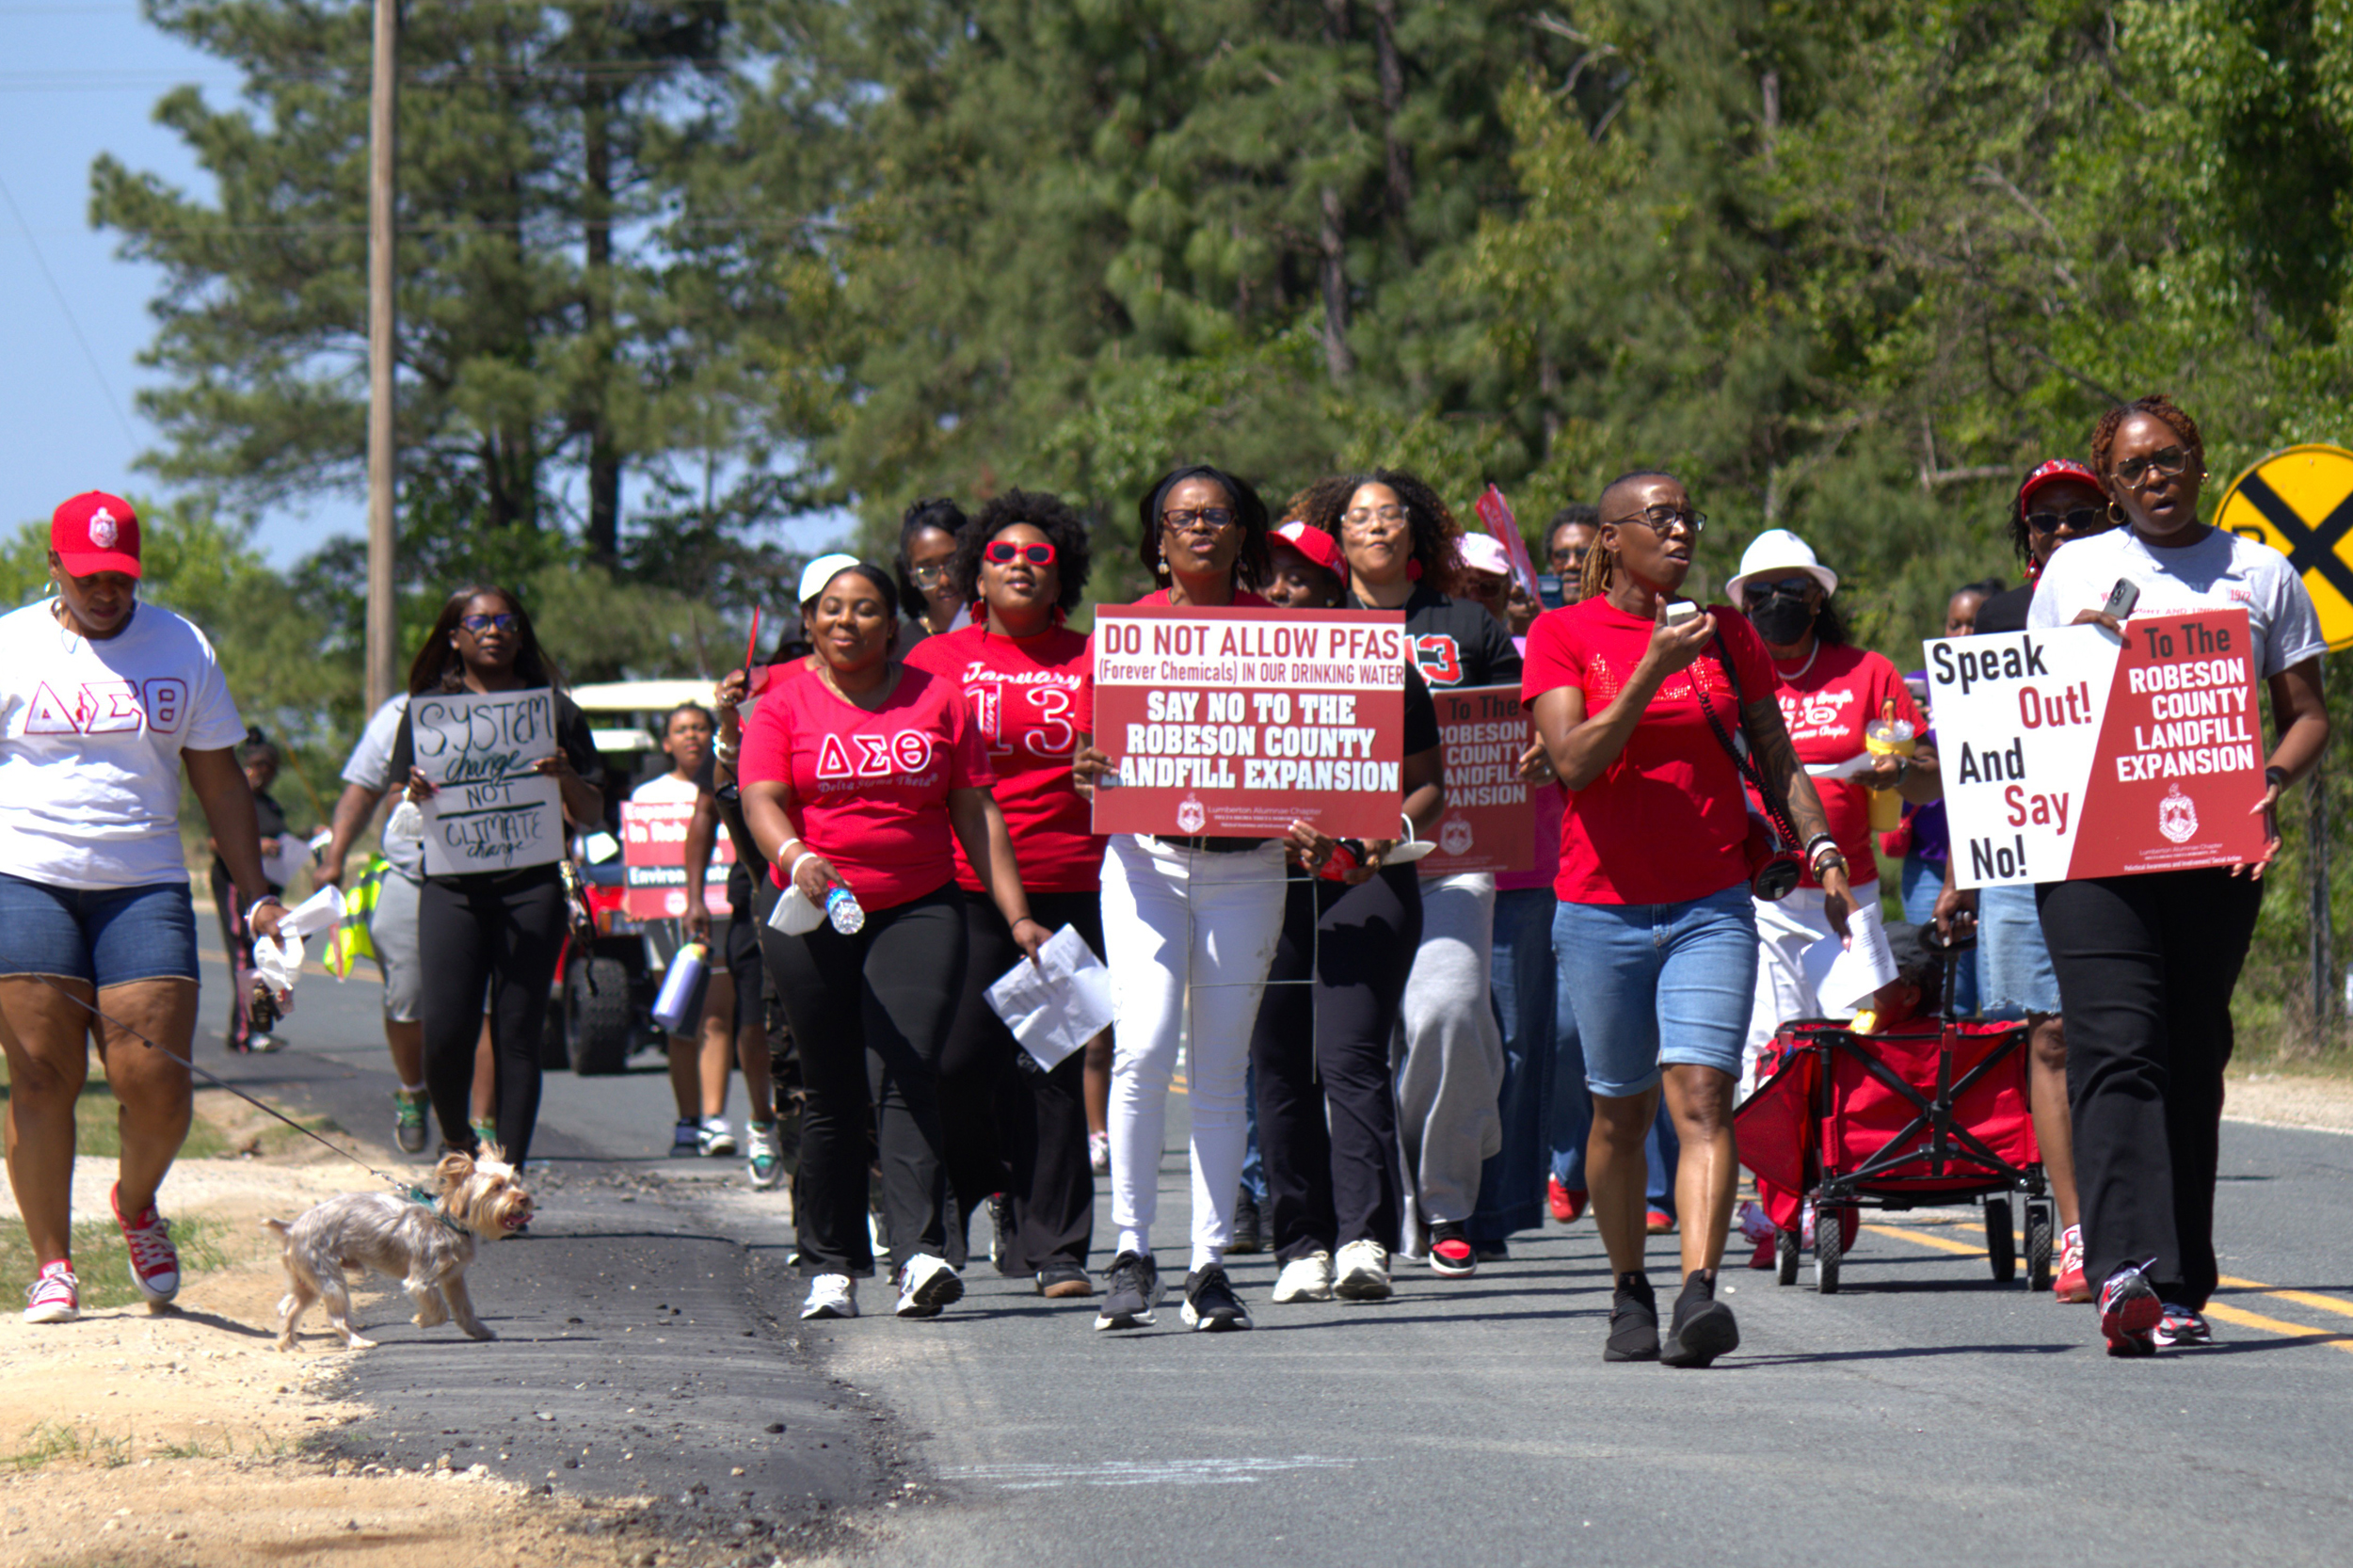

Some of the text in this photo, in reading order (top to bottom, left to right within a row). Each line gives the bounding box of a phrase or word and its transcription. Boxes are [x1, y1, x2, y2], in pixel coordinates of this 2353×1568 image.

[2230, 589, 2251, 602] 1972
[1105, 623, 1401, 660] DO NOT ALLOW PFAS
[2143, 622, 2232, 659] To The
[963, 662, 1081, 690] January
[1098, 658, 1404, 685] (Forever Chemicals) IN OUR DRINKING WATER
[1932, 634, 2049, 695] Speak
[2129, 657, 2246, 695] ROBESON
[1146, 690, 1357, 726] SAY NO TO THE
[1448, 694, 1519, 721] To The
[2018, 680, 2092, 729] Out!
[2152, 685, 2249, 721] COUNTY
[419, 696, 553, 757] SYSTEM
[1127, 723, 1376, 759] ROBESON COUNTY
[2135, 715, 2252, 752] LANDFILL
[445, 750, 531, 786] change
[817, 729, 932, 779] ΔΣΘ
[1447, 742, 1529, 765] COUNTY
[1959, 737, 2025, 785] And
[2116, 744, 2255, 782] EXPANSION
[1243, 758, 1400, 792] EXPANSION
[1444, 763, 1521, 787] ANDFIL
[466, 782, 515, 808] NOT
[2004, 784, 2069, 836] Say
[445, 811, 542, 846] CLIMATE
[1969, 834, 2027, 881] No!
